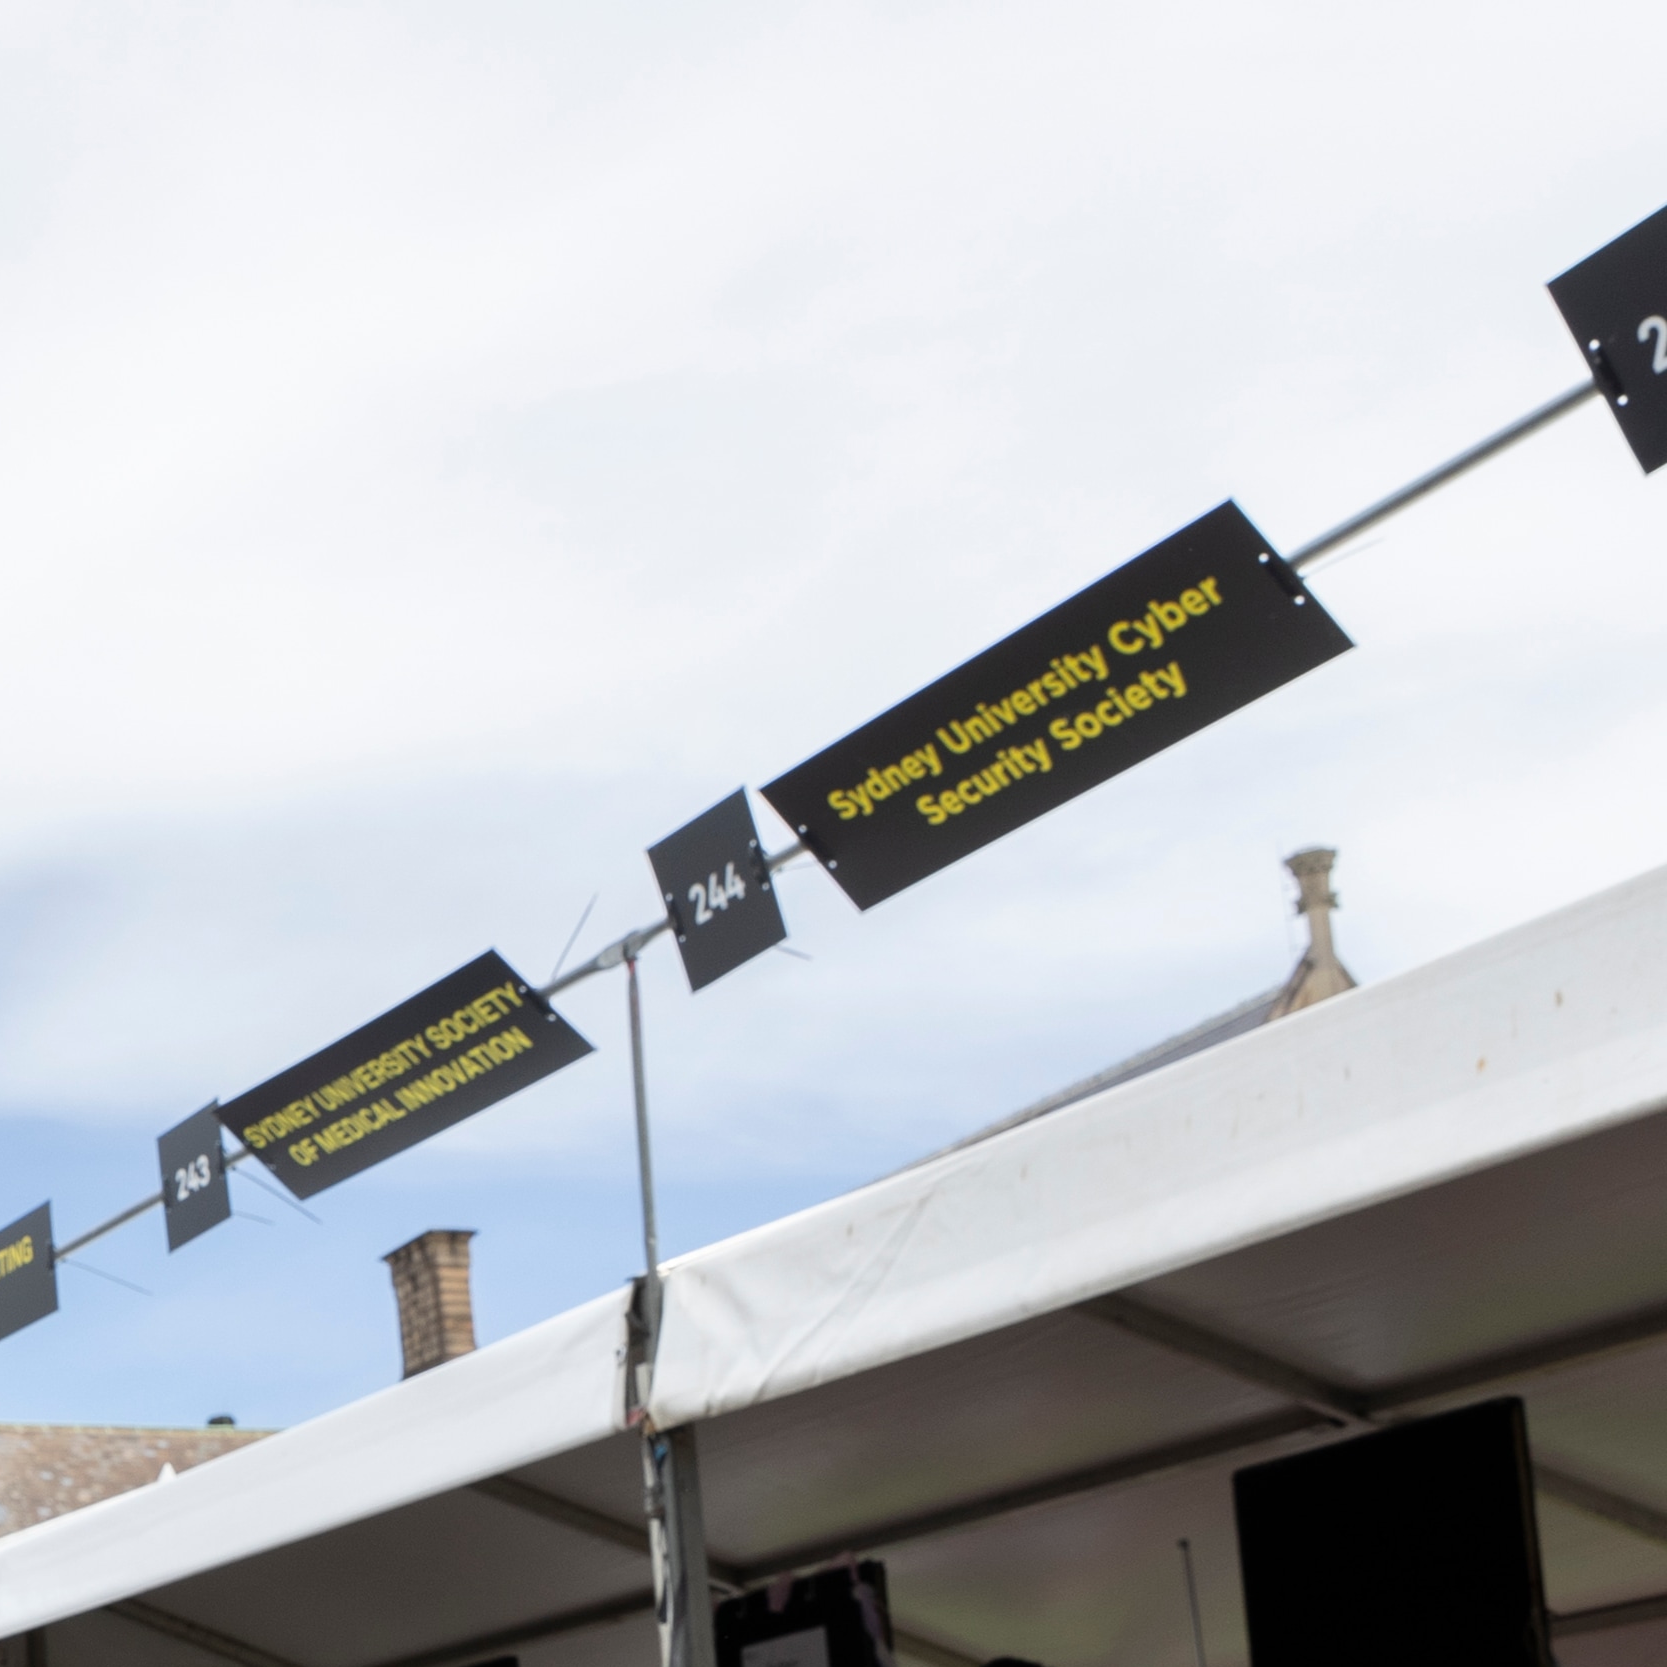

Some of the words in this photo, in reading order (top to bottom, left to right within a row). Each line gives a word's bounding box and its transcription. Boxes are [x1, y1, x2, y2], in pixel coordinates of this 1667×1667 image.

[827, 741, 943, 821] Sydney
[935, 644, 1110, 756] University
[1107, 575, 1224, 656] Cyber
[915, 737, 1054, 826] Security
[1049, 661, 1189, 751] Society
[688, 862, 747, 926] 244
[242, 1096, 322, 1150] SYDNEY
[314, 1034, 433, 1112] UNIVERSITY
[424, 981, 524, 1051] SOCIETY
[288, 1136, 321, 1168] OF
[313, 1097, 408, 1155] MEDICAL
[394, 1025, 534, 1112] INNOVATION
[175, 1154, 212, 1202] 243
